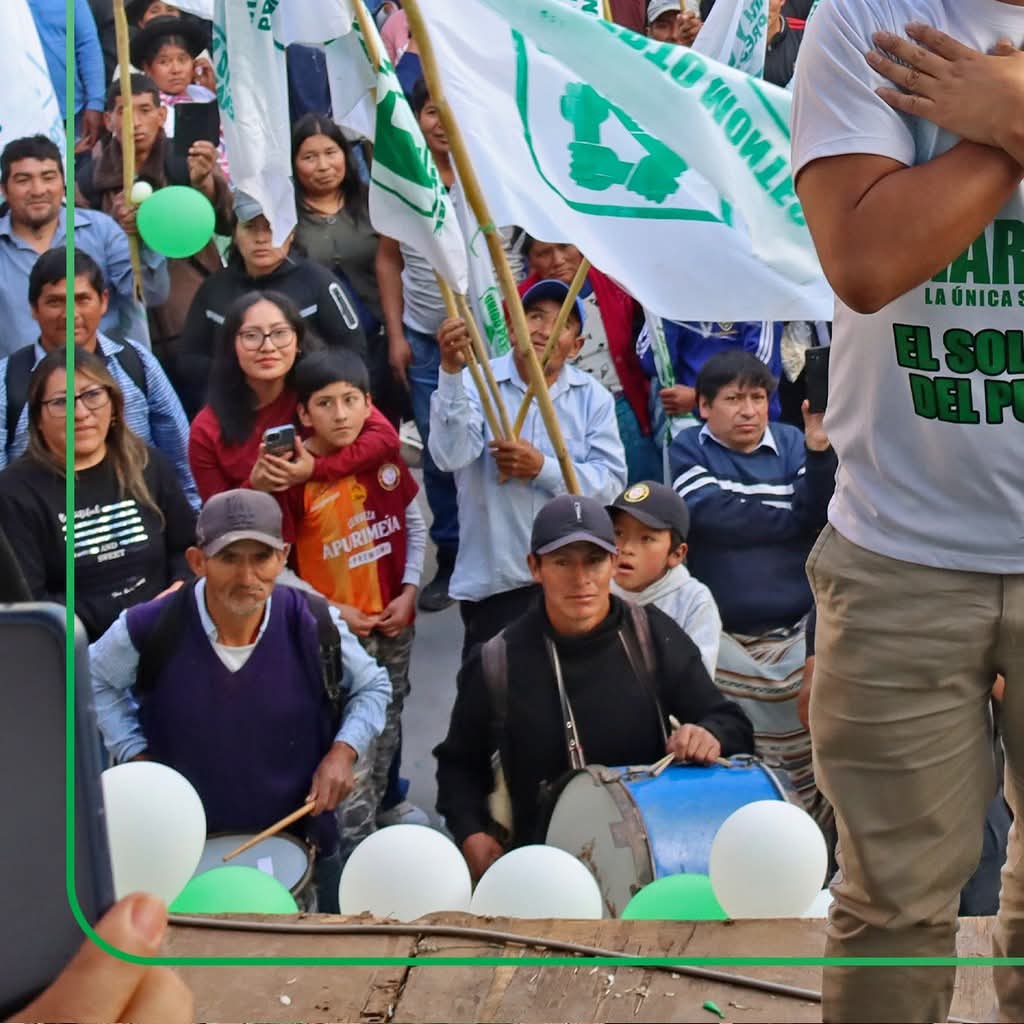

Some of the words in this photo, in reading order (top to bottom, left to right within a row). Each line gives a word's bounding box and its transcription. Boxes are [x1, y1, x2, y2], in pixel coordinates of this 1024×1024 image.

[925, 286, 946, 307] LA
[952, 281, 1013, 308] ÚNICA
[892, 322, 940, 372] EL
[908, 372, 981, 425] DEL
